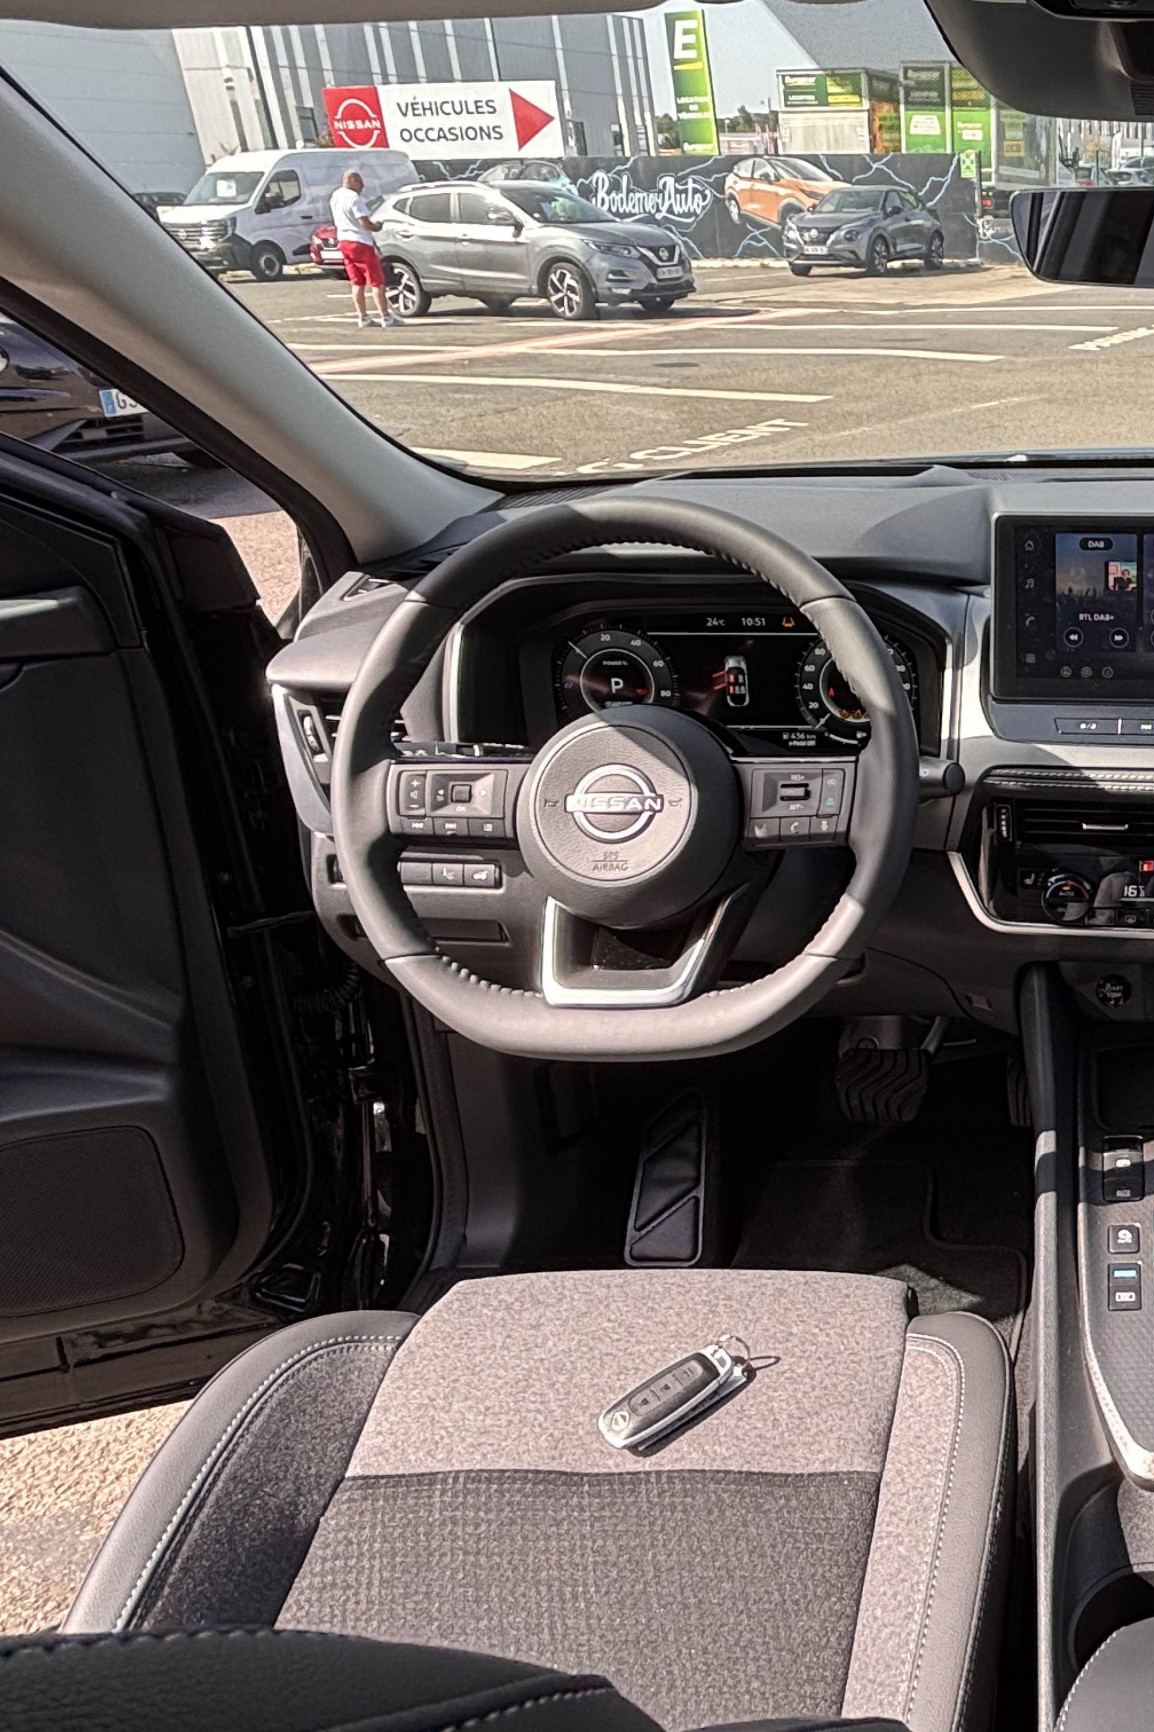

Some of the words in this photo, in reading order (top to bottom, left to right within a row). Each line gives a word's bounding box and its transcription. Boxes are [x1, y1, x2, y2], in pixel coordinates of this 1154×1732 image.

[673, 19, 699, 59] E
[397, 95, 497, 117] VÉHICULES
[334, 119, 381, 130] NISSAN
[400, 125, 504, 143] OCCASIONS
[630, 418, 809, 460] CLIENT
[1087, 540, 1105, 549] DAB
[741, 617, 766, 626] 10:51
[600, 633, 611, 641] 20
[611, 678, 624, 694] P
[569, 797, 661, 811] NISSAN
[592, 862, 629, 872] AIRBAG
